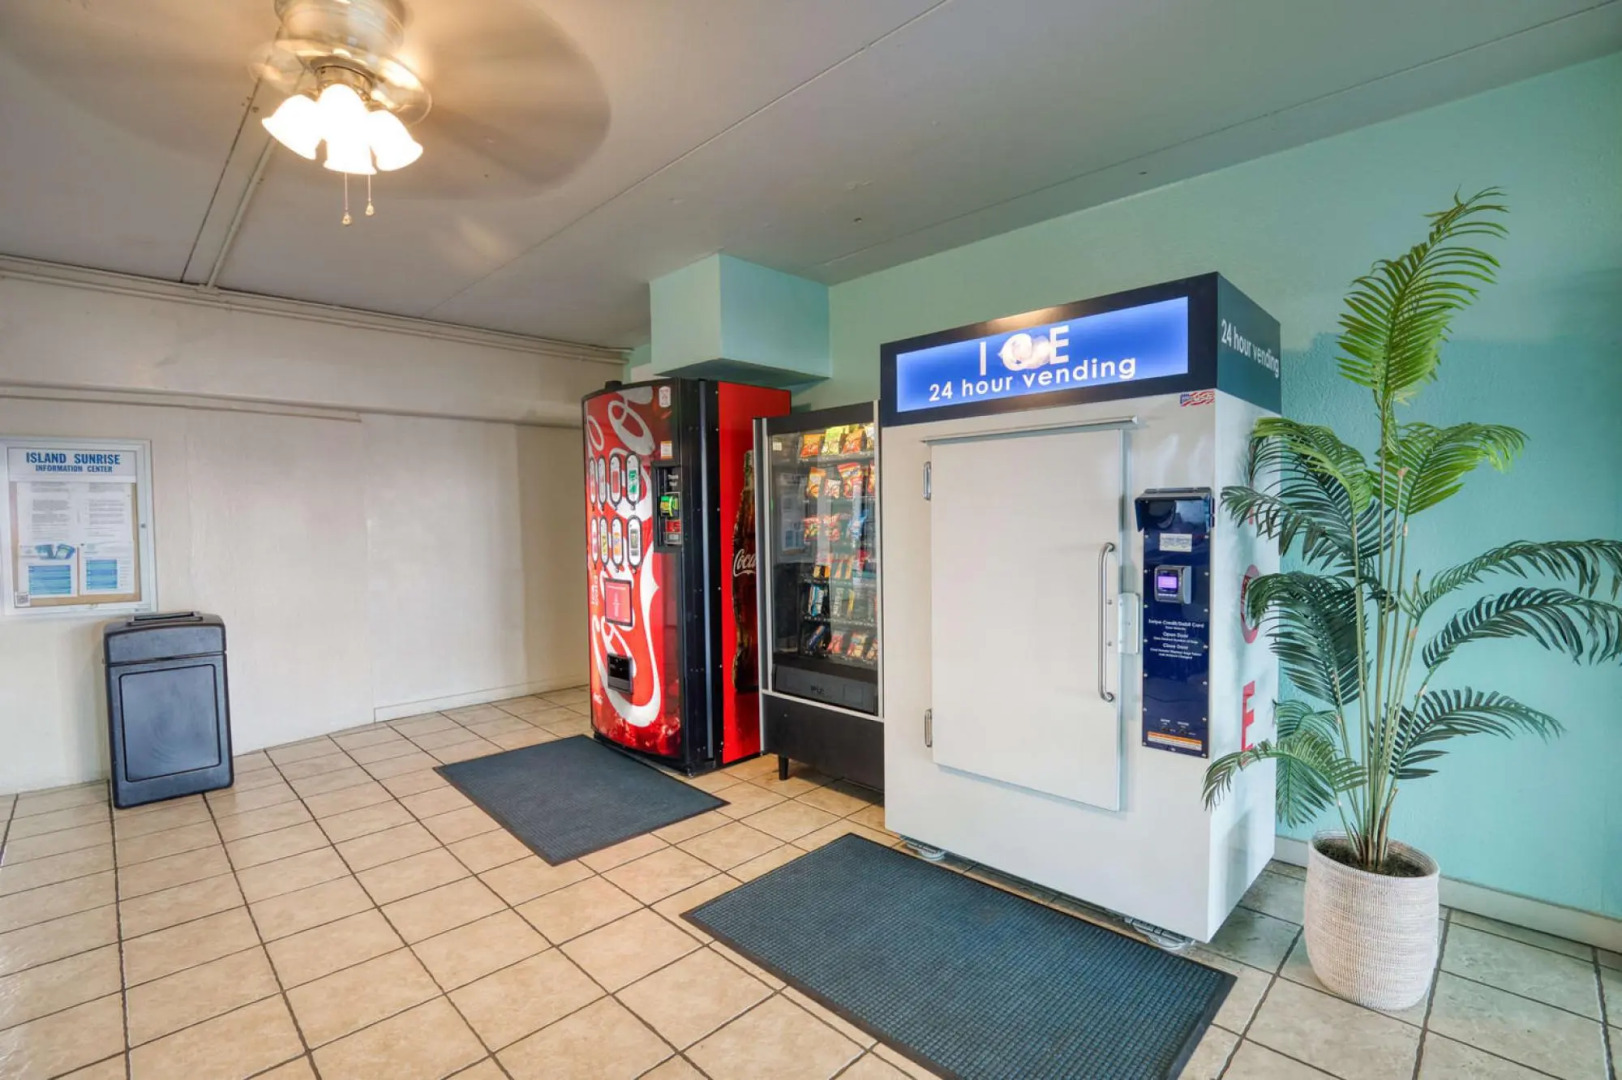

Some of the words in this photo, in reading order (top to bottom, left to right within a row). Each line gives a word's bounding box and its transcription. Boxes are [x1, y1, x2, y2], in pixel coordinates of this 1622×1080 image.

[1221, 318, 1233, 348] 24
[1233, 325, 1252, 359] hour
[1252, 343, 1280, 379] vending
[928, 381, 954, 402] 24
[961, 375, 1013, 398] hour
[1022, 357, 1136, 389] vending
[26, 451, 67, 464] ISLAND
[74, 453, 121, 465] SUNRISE
[35, 464, 83, 473] INFORMATION
[87, 465, 113, 473] CENTER
